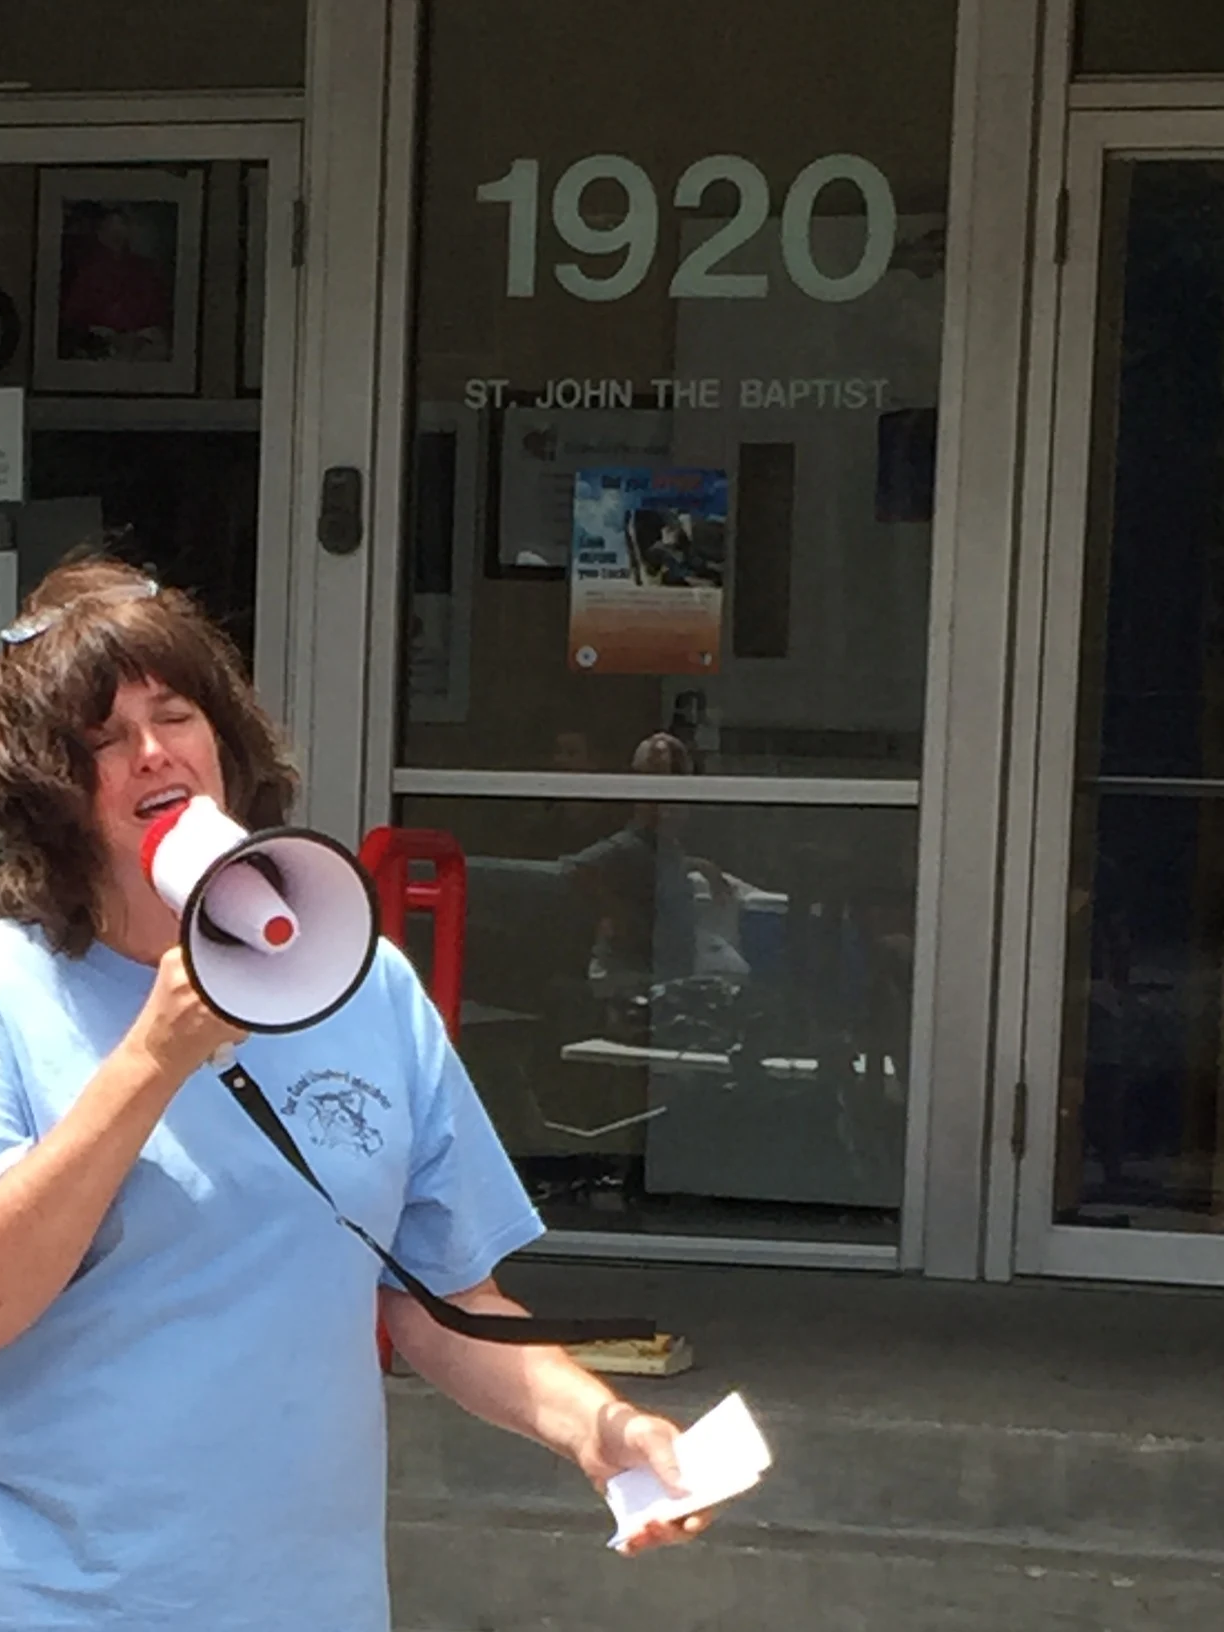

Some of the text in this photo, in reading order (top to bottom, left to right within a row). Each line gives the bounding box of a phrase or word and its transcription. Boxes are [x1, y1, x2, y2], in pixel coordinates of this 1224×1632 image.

[477, 153, 897, 302] 1920
[463, 378, 889, 410] ST. JOHN THE BAPTIST
